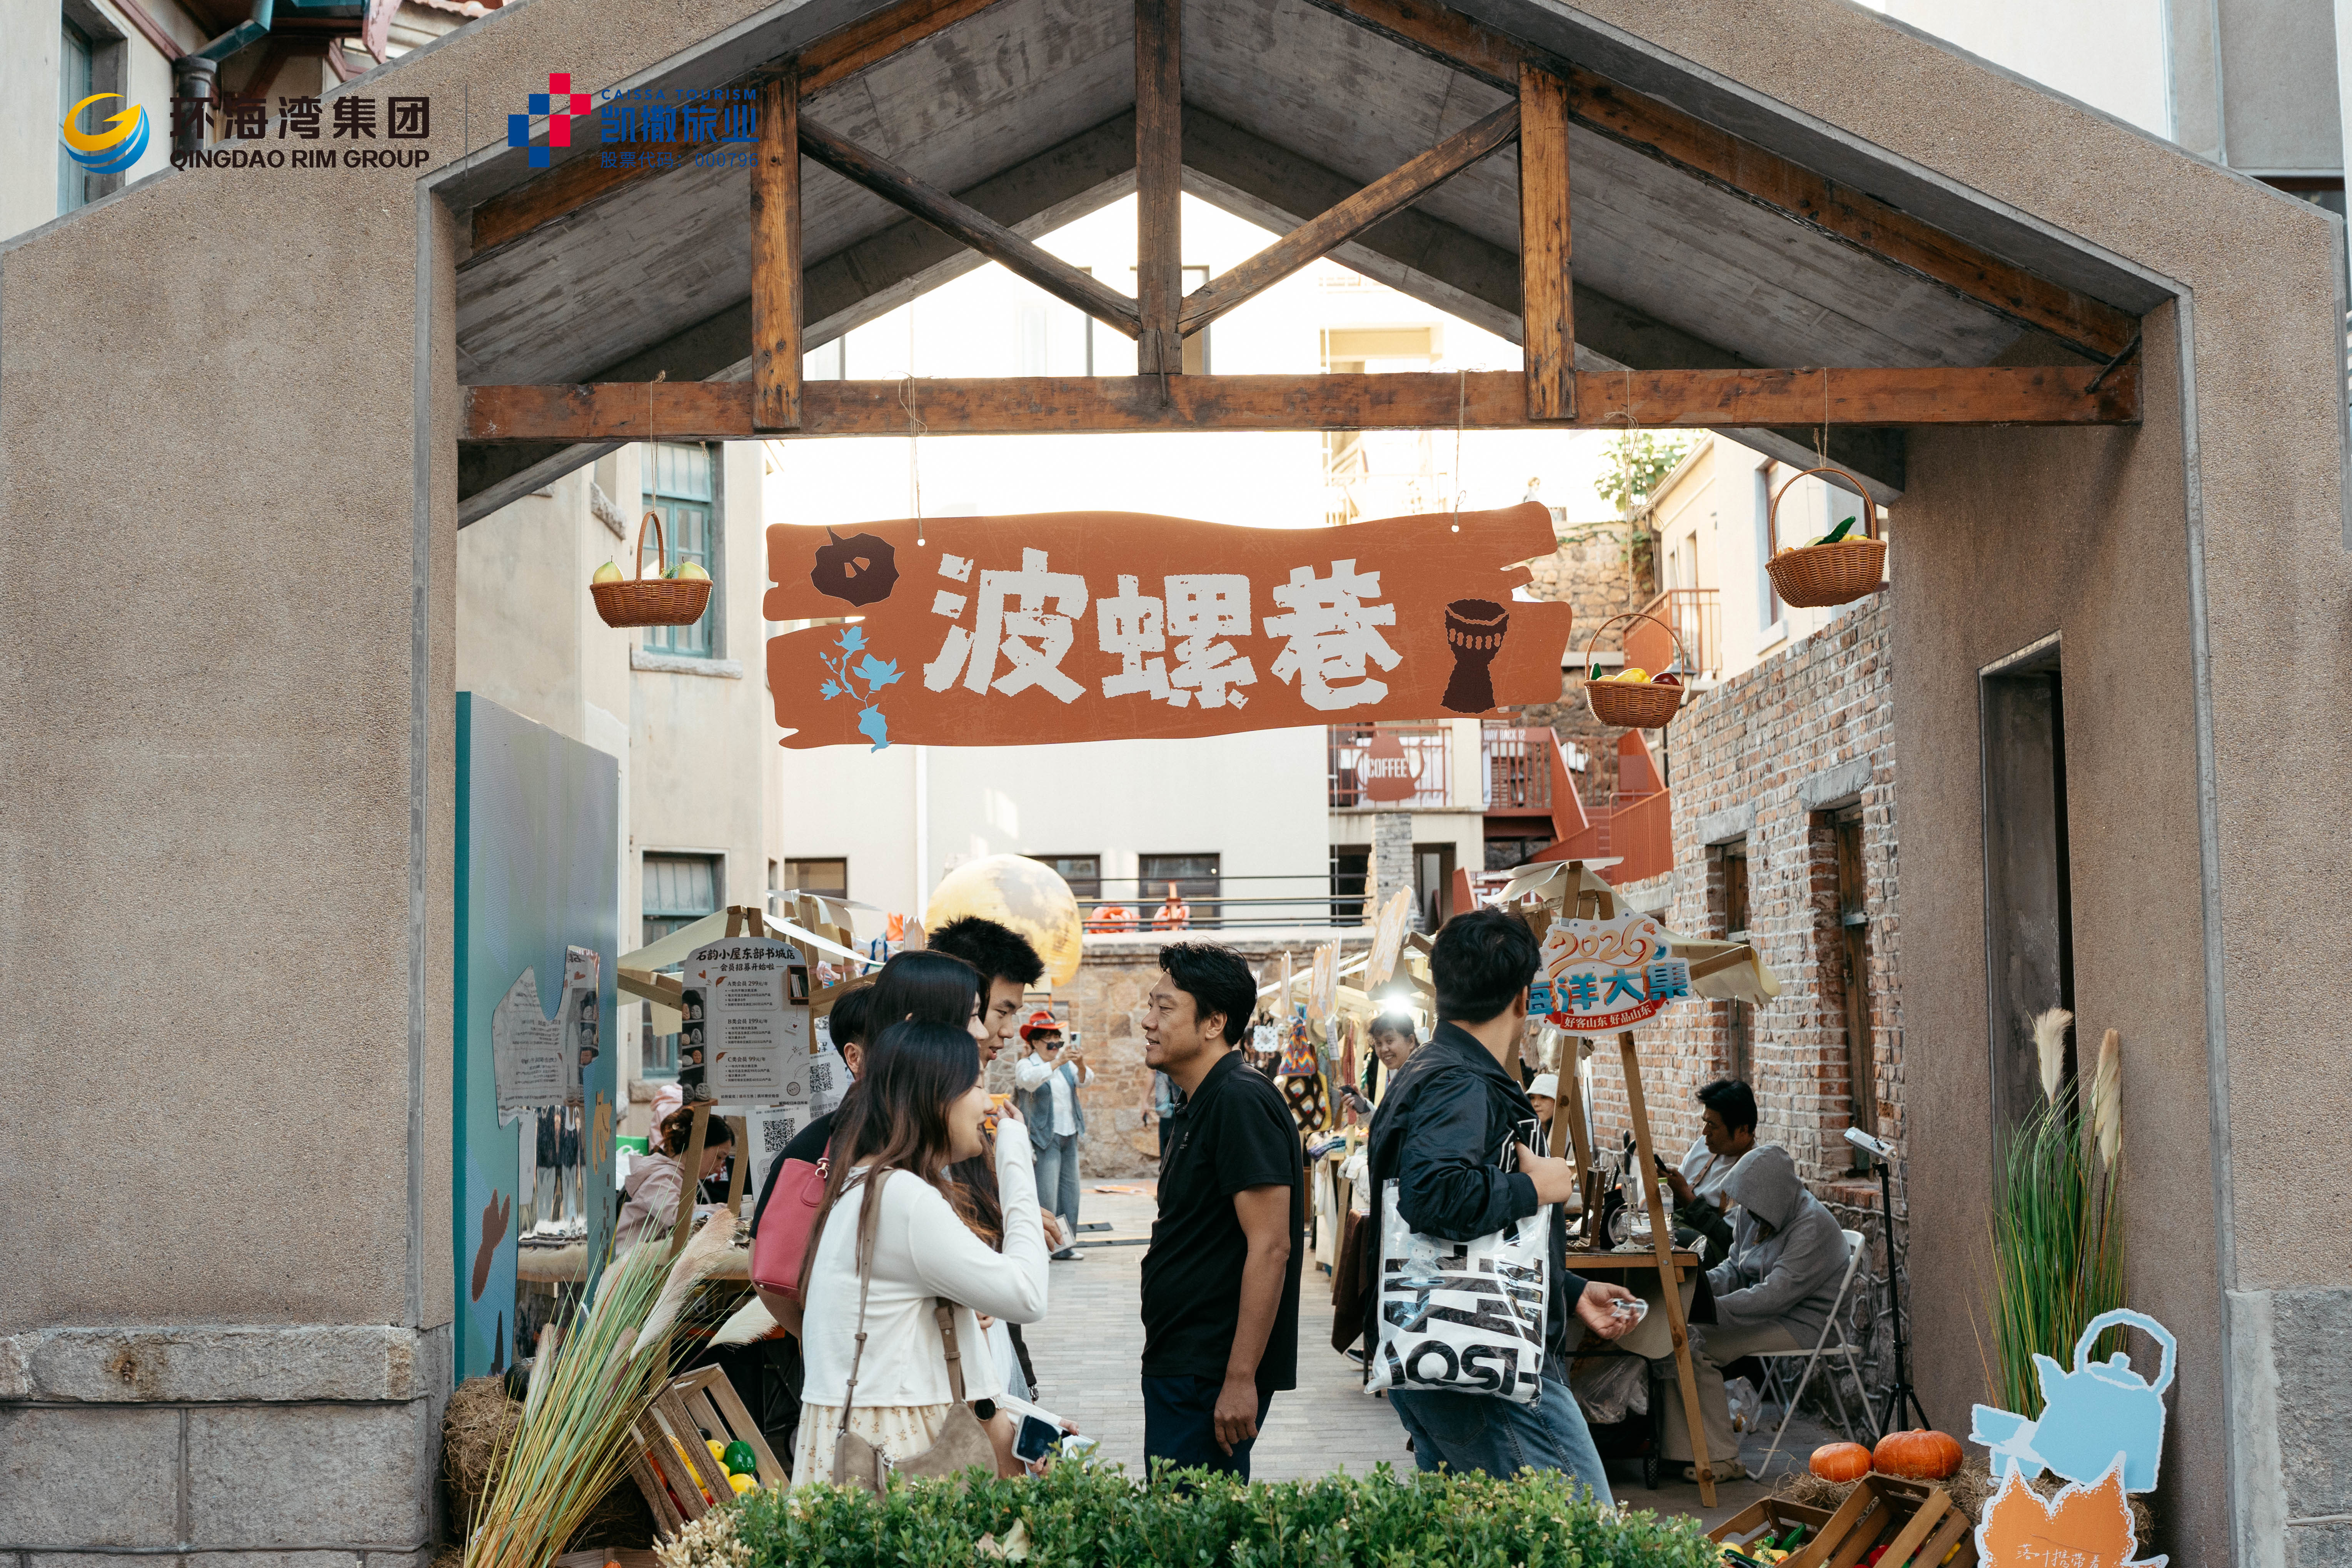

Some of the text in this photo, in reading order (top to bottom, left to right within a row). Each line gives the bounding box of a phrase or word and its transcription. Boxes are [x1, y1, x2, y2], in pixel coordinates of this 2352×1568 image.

[922, 547, 1403, 711] 波螺巷
[1483, 729, 1526, 741] WAY BACK 12
[1367, 757, 1408, 778] COFFEE
[696, 947, 796, 961] 石韵小屋东部书城店
[1547, 918, 1656, 979] 2026
[720, 962, 775, 972] 会员招募开始啦
[1564, 1004, 1652, 1028] 好客山东 好品山东
